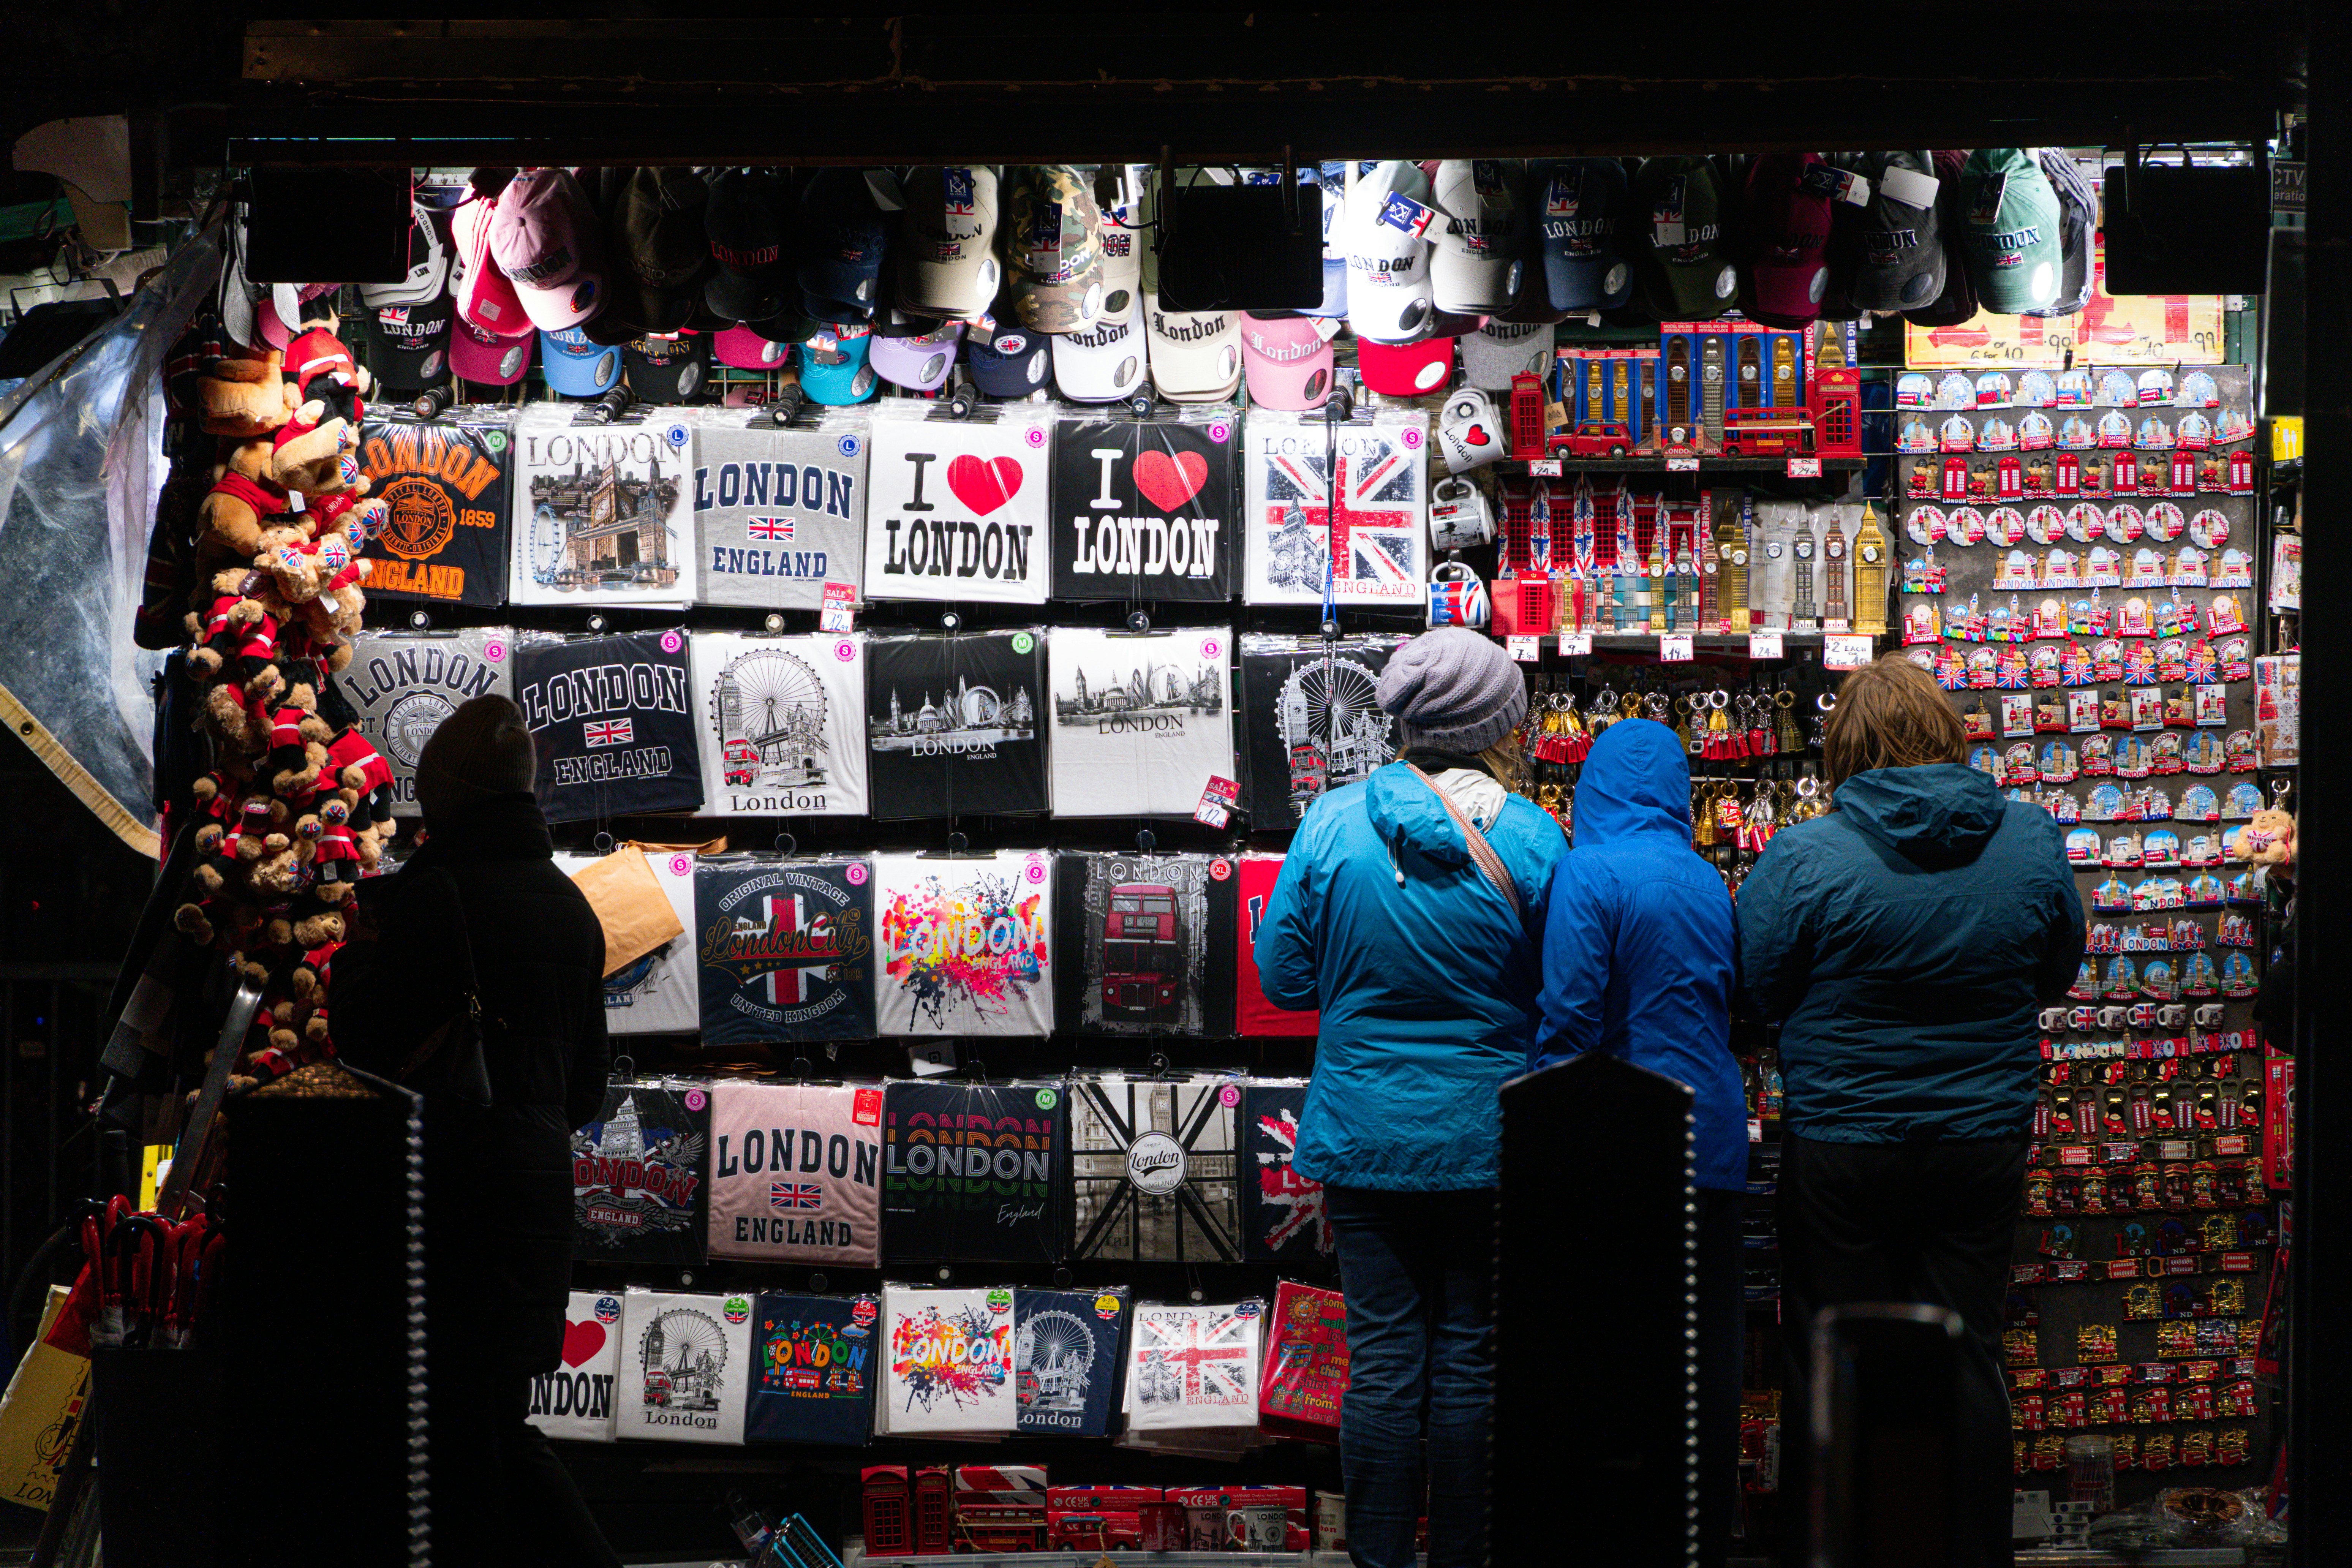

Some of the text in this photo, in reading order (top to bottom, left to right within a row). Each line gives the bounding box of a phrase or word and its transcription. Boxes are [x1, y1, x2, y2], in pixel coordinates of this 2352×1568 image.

[416, 208, 433, 241] LONDON
[1446, 218, 1515, 236] LONDON
[1543, 218, 1616, 239] LONDON
[711, 241, 779, 267] LONDON
[1346, 253, 1416, 272] LONDON
[1672, 252, 1709, 263] ENGLAND
[383, 319, 446, 337] LONDON
[1153, 311, 1225, 343] London
[1251, 330, 1322, 362] London
[1848, 340, 1856, 362] BEN
[2004, 347, 2024, 360] 10
[1807, 359, 1815, 381] BOX
[1033, 433, 1039, 441] S
[1216, 428, 1222, 436] S
[1409, 433, 1415, 442] S
[2222, 434, 2248, 443] LONDON
[528, 432, 682, 466] LONDON
[1444, 426, 1473, 464] London
[903, 453, 937, 512] I
[1090, 449, 1124, 509] I
[694, 461, 854, 521] LONDON
[395, 514, 433, 526] LONDON
[459, 509, 496, 528] 1859
[1702, 495, 1710, 535] MONEY
[884, 518, 1033, 581] LONDON
[1073, 514, 1219, 577] LONDON
[712, 545, 828, 578] ENGLAND
[1332, 581, 1416, 596] ENGLAND
[2036, 577, 2078, 589] LONDON
[2078, 575, 2120, 588] LONDON
[826, 590, 846, 598] SALE
[2159, 620, 2201, 638] LONDON
[2214, 624, 2242, 634] LONDON
[343, 647, 499, 708] LONDON
[523, 663, 687, 732] LONDON
[1098, 713, 1184, 735] LONDON
[911, 736, 995, 757] LONDON
[554, 746, 673, 786] ENGLAND
[1208, 782, 1228, 794] SALE
[730, 790, 827, 812] London
[1097, 863, 1200, 881] LONDON
[719, 872, 849, 911] ORIGINAL VINTAGE
[733, 920, 767, 931] ENGLAND
[889, 915, 1039, 961] LONDON
[2216, 936, 2254, 947] LONDON
[2085, 944, 2120, 953] LONDON
[972, 953, 1034, 970] ENGLAND
[826, 968, 862, 981] EST. 1889
[730, 988, 847, 1023] UNITED KINGDOM
[717, 1127, 879, 1189] LONDON
[886, 1144, 1049, 1182] LONDON
[1129, 1150, 1180, 1171] London
[1145, 1180, 1175, 1189] ENGLAND
[591, 1193, 617, 1204] SINCE
[590, 1210, 639, 1225] ENGLAND
[997, 1202, 1045, 1227] England
[735, 1217, 852, 1247] ENGLAND
[762, 1340, 868, 1370] LONDON
[894, 1338, 1009, 1364] LONDON
[1331, 1355, 1349, 1365] me
[955, 1364, 1002, 1375] ENGLAND
[1320, 1365, 1341, 1378] this
[1186, 1393, 1249, 1405] ENGLAND
[646, 1411, 718, 1427] London
[1065, 1497, 1076, 1508] CE
[1191, 1495, 1203, 1506] CE
